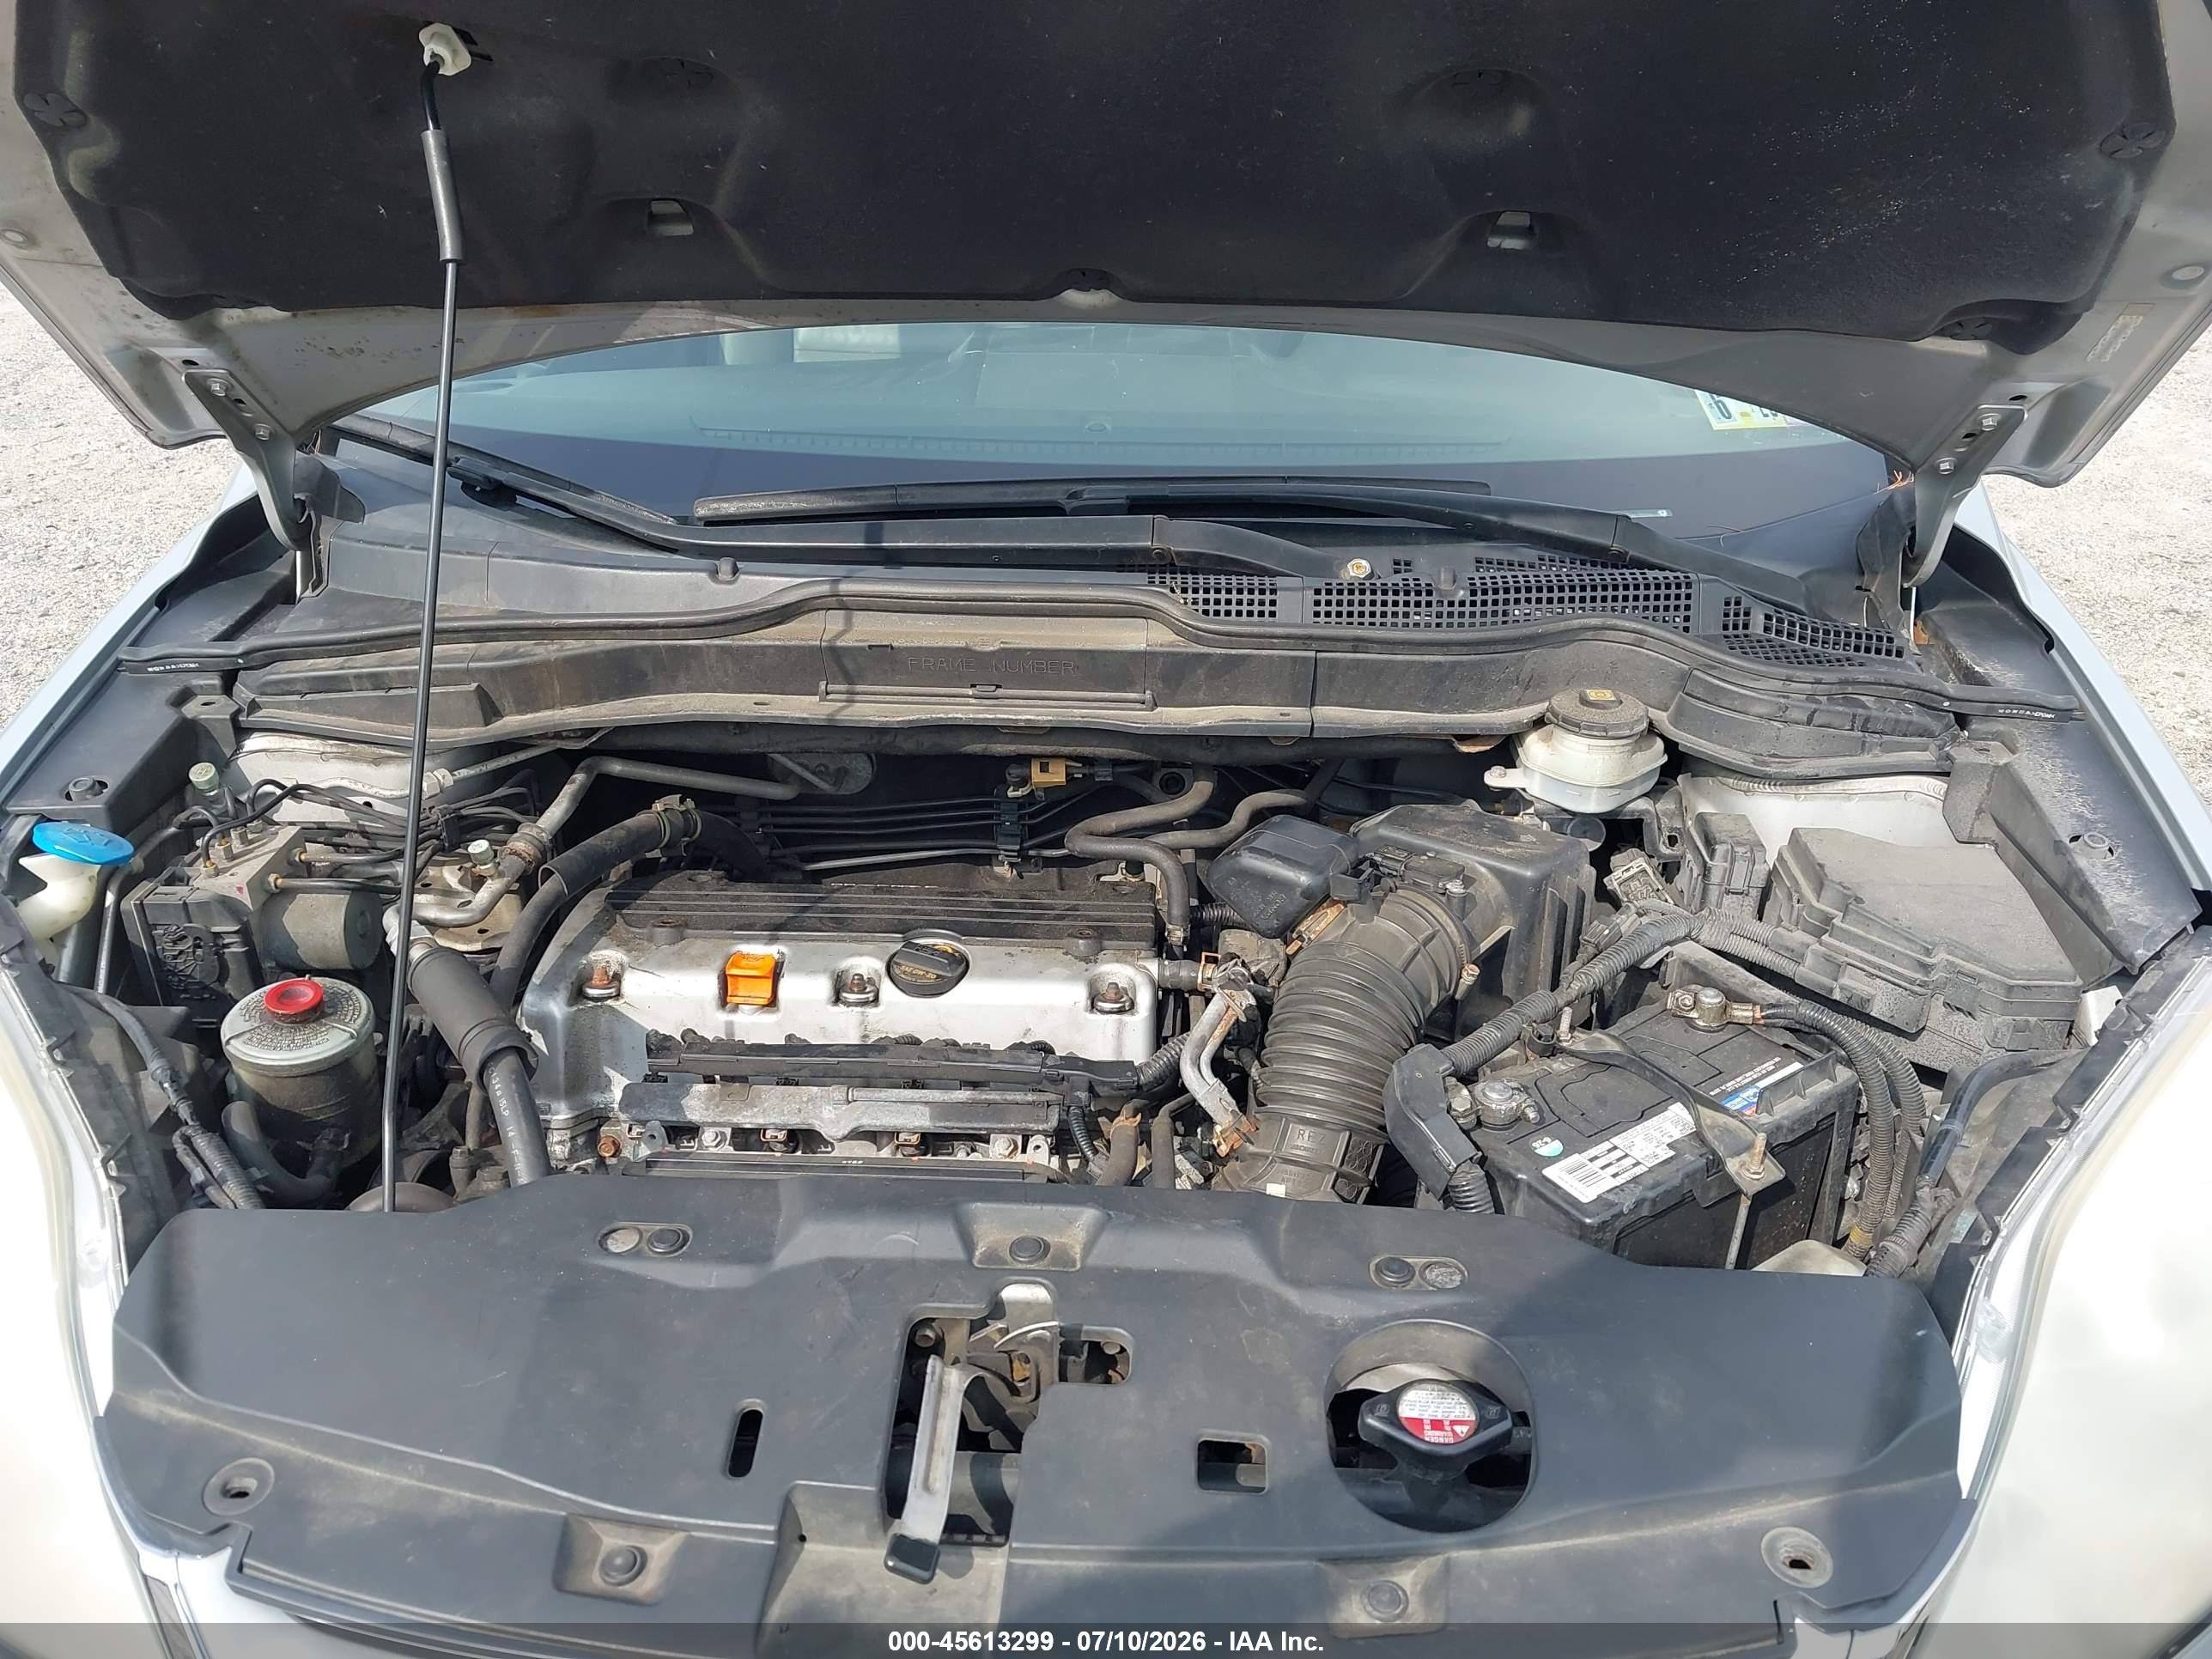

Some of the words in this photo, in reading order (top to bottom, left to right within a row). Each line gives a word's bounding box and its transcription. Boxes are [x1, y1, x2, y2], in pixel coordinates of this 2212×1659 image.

[908, 657, 976, 672] FRAME
[990, 659, 1075, 674] NUMBER
[912, 968, 937, 979] 0W-20
